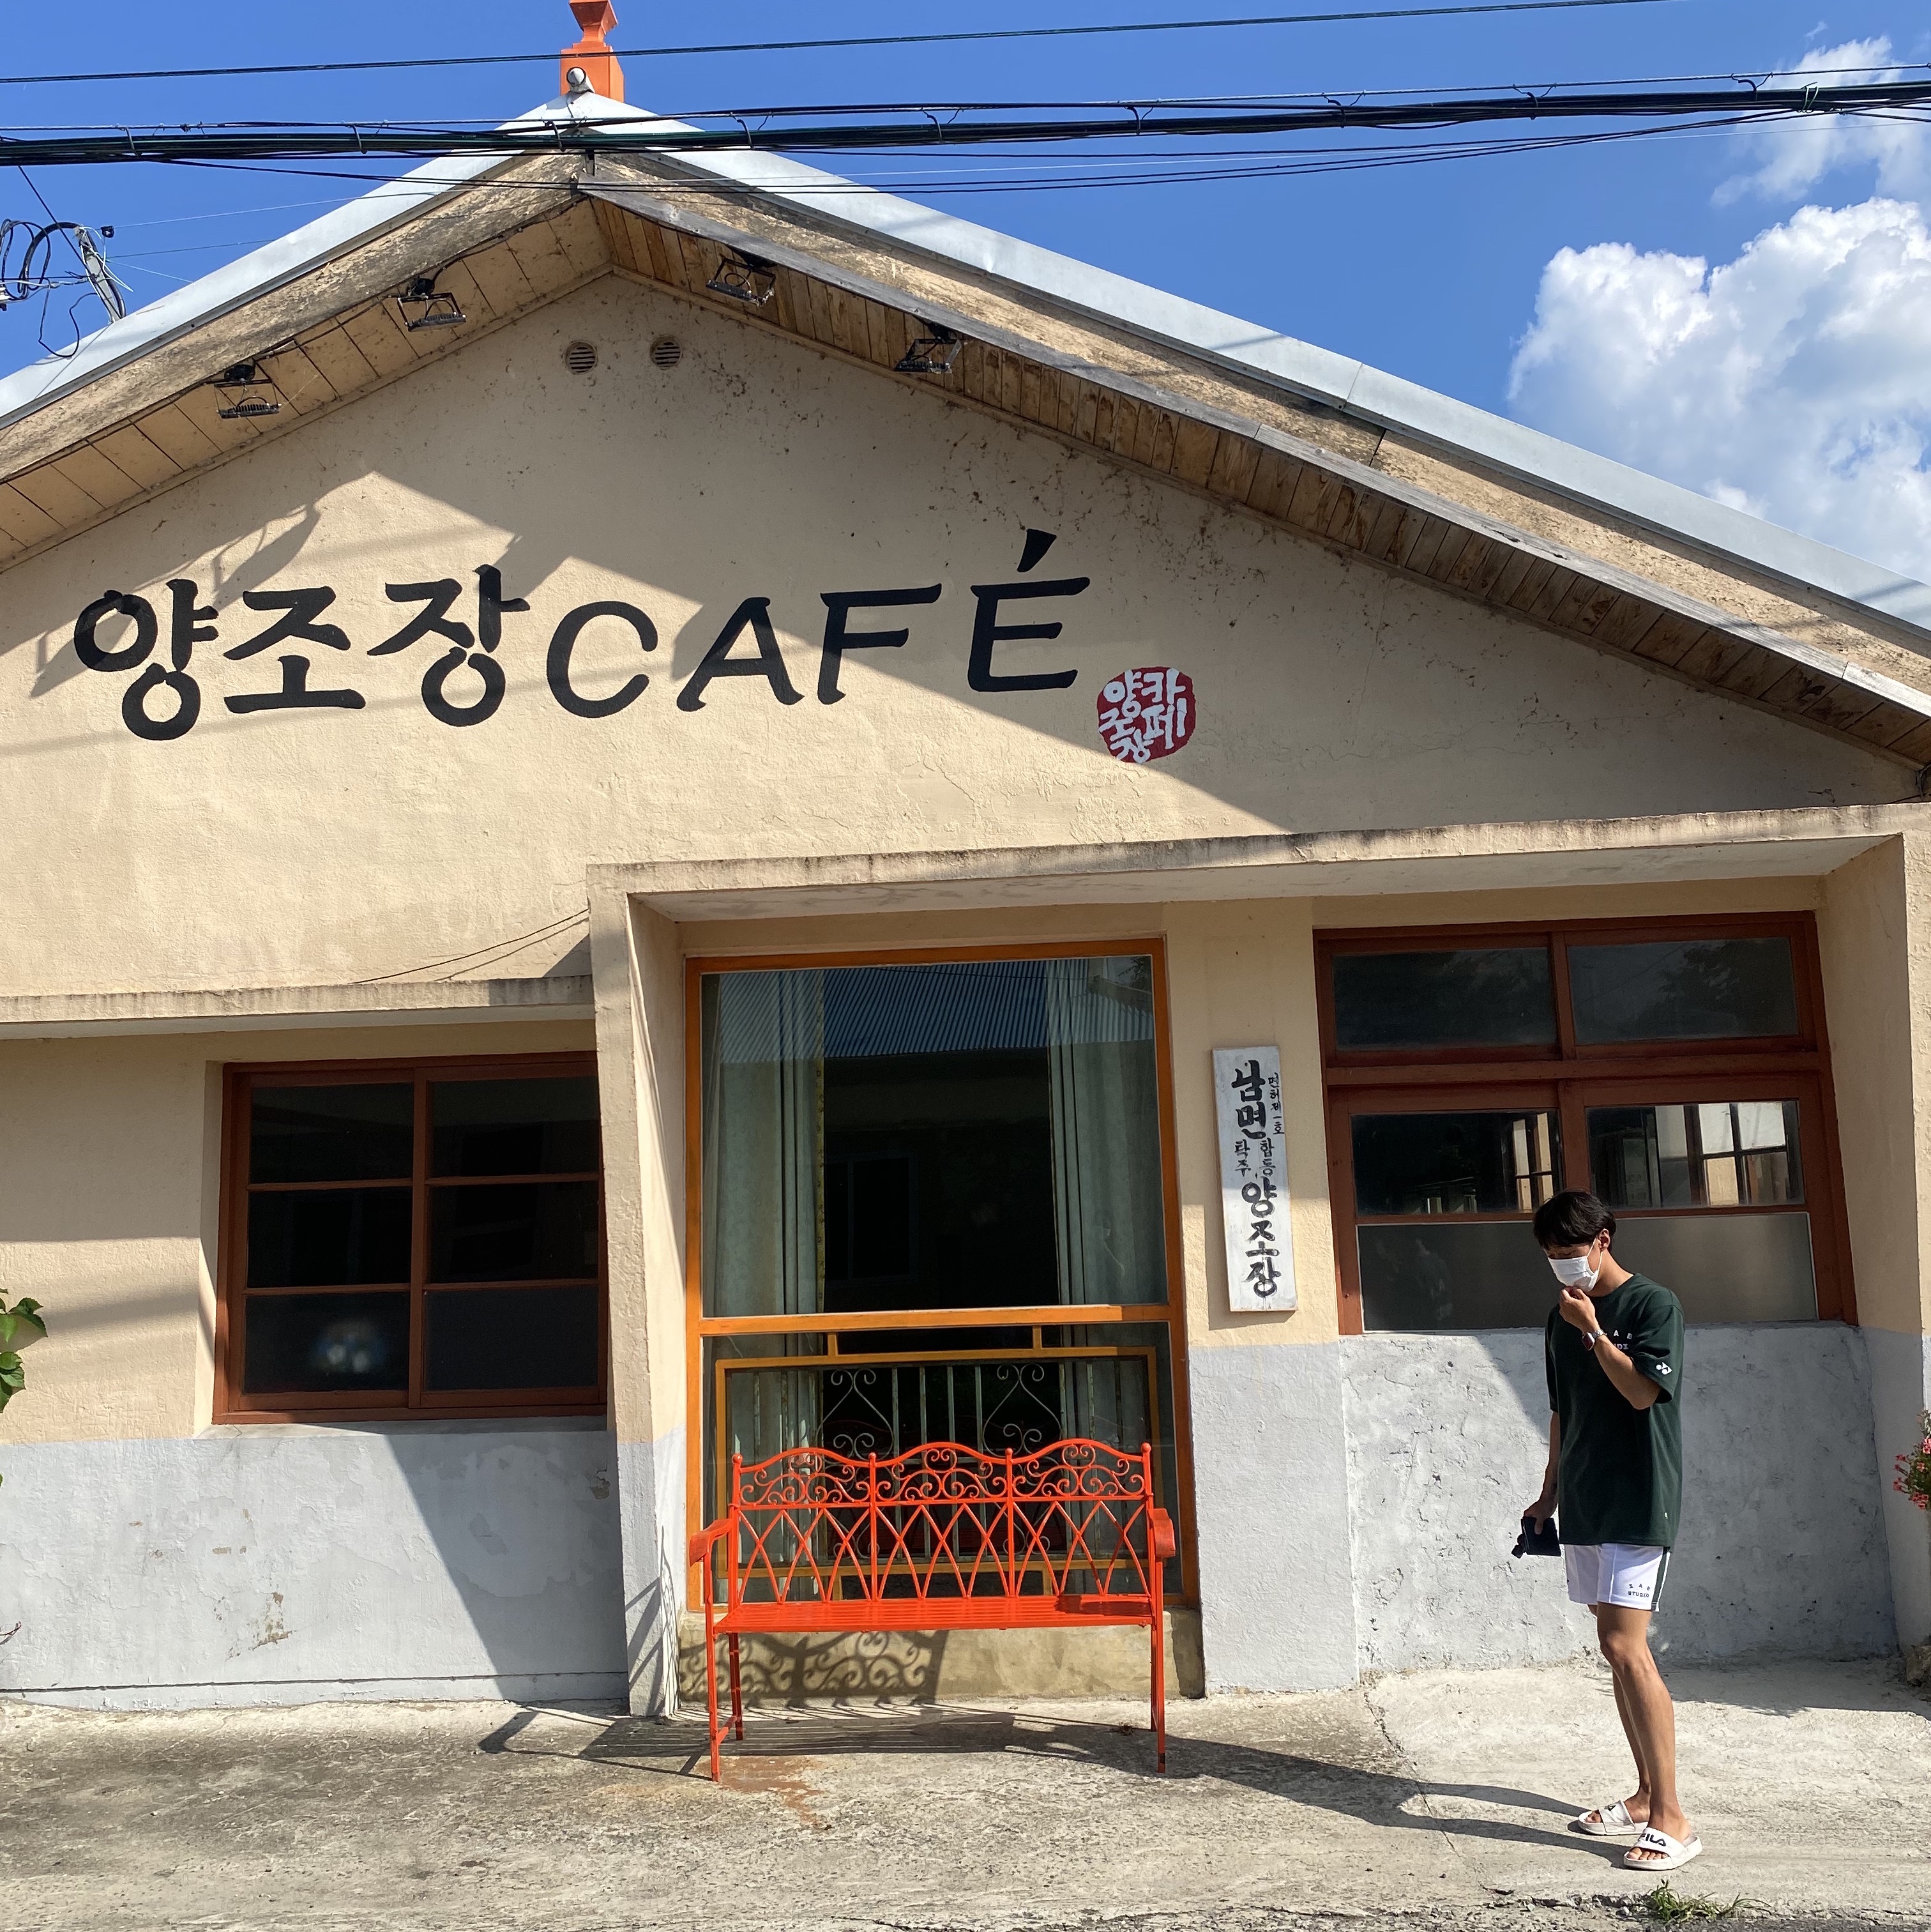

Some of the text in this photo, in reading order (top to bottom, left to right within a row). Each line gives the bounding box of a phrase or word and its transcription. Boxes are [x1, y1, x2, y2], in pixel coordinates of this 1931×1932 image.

[73, 565, 531, 742] 양조장
[1231, 1060, 1267, 1139] 남면
[1241, 1176, 1282, 1298] 양조장
